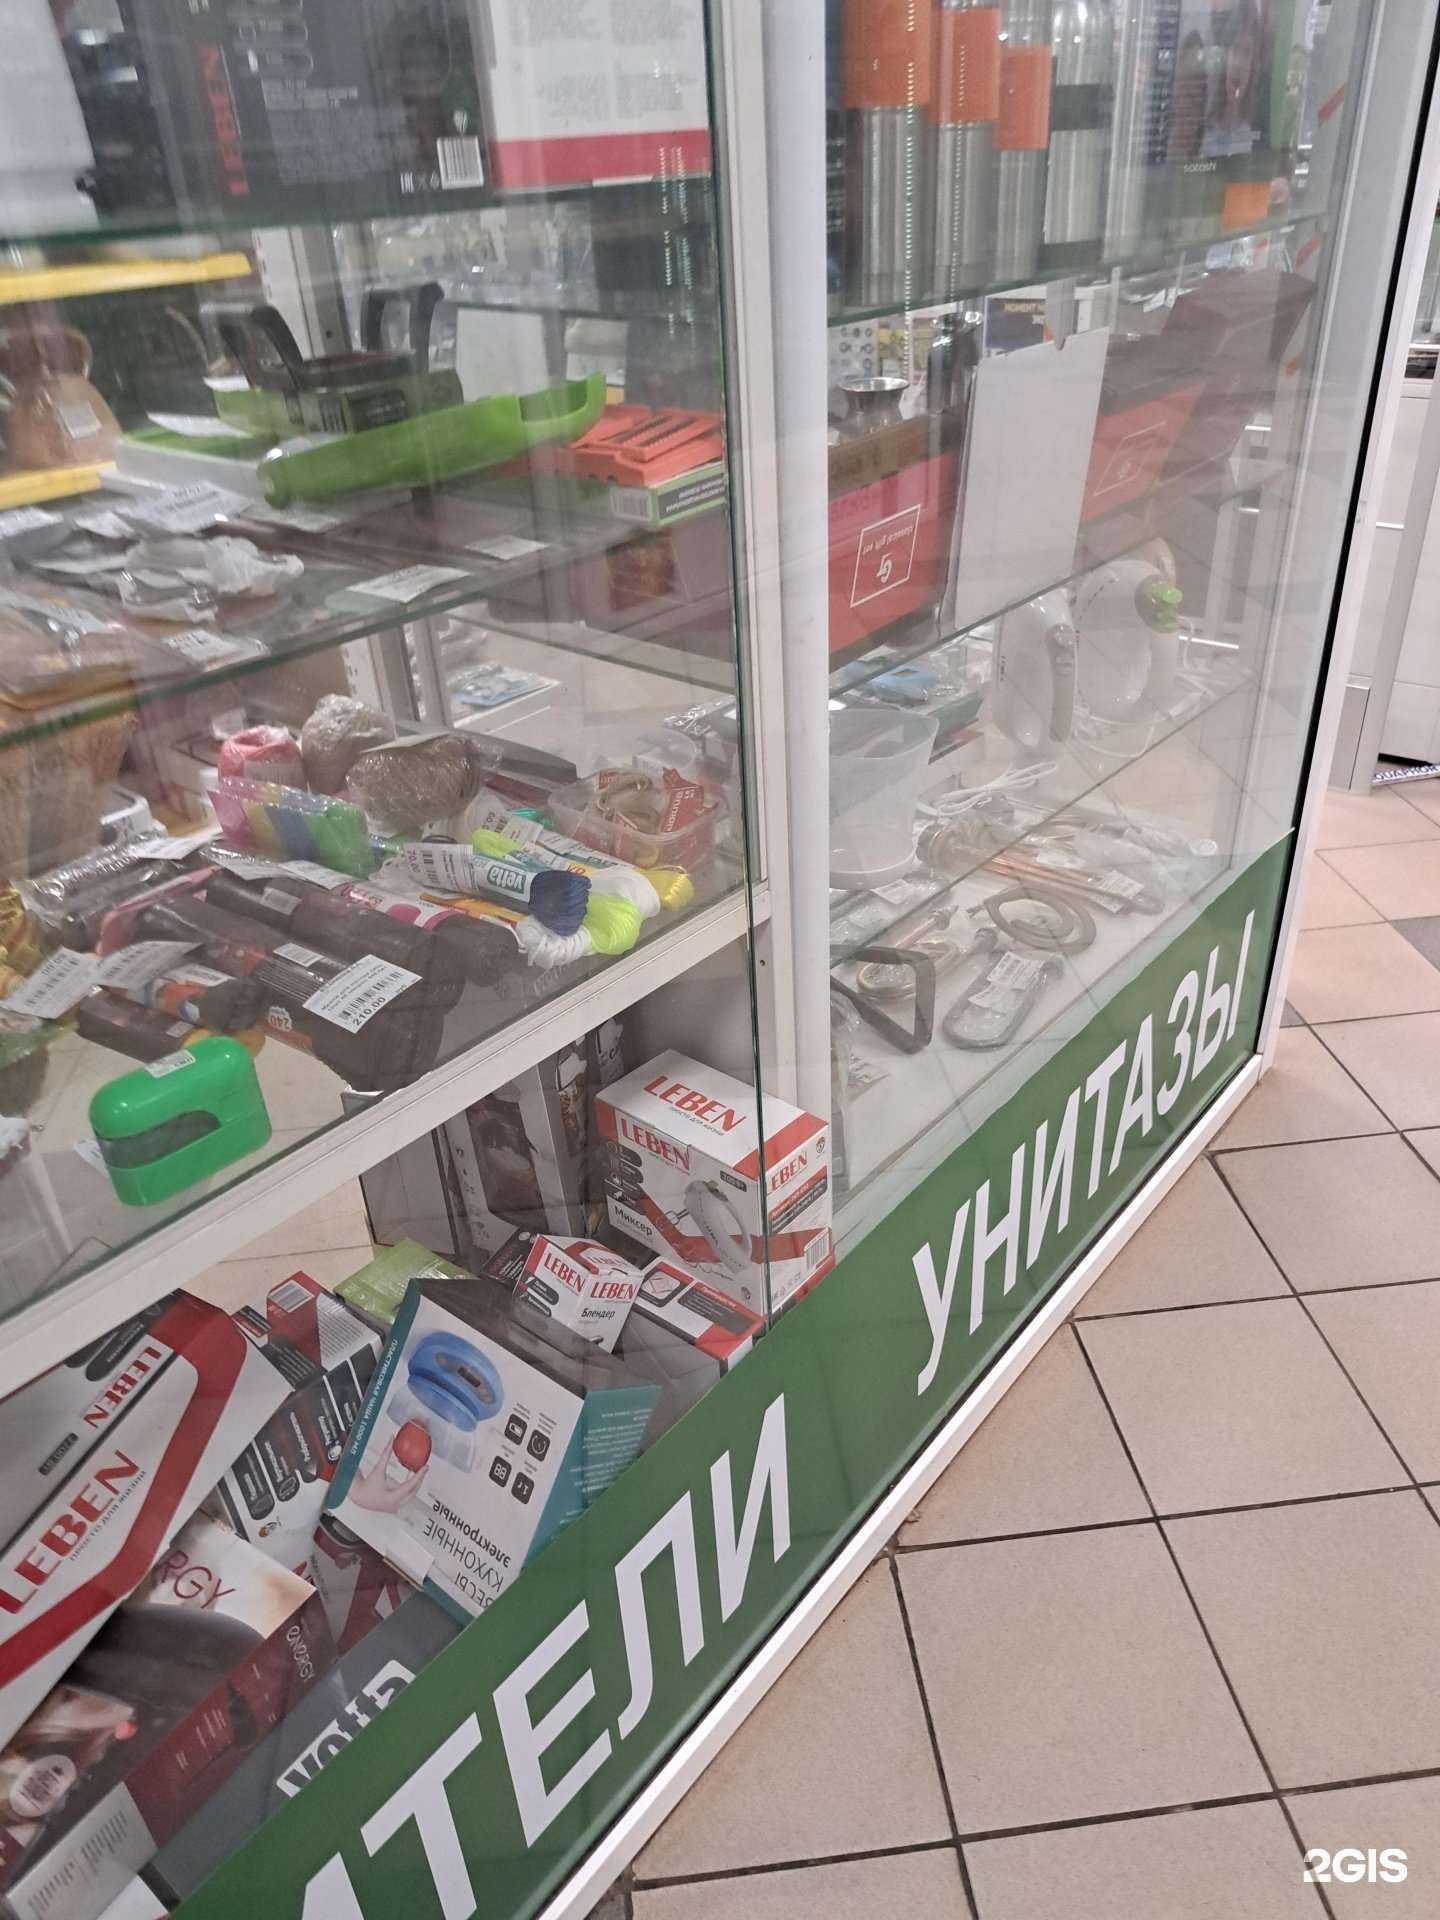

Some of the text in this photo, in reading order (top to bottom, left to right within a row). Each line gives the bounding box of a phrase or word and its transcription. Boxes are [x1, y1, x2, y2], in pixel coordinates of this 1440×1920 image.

[352, 996, 387, 1026] 210.00
[643, 1075, 748, 1133] LEBEN
[620, 1118, 691, 1173] LEBEN
[770, 1151, 809, 1191] EBEN
[912, 909, 1256, 1396] УНИТАЗЫ
[614, 1205, 654, 1237] Миксер
[543, 1252, 586, 1293] LEBEN
[590, 1281, 638, 1300] LEBEN
[580, 1307, 616, 1321] Блендер
[0, 1448, 141, 1615] LEBEN
[423, 1517, 504, 1593] КУХОННЫЕ
[432, 1499, 512, 1568] электронные
[163, 1549, 236, 1610] RGY
[302, 1392, 791, 1920] ТЕЛИ
